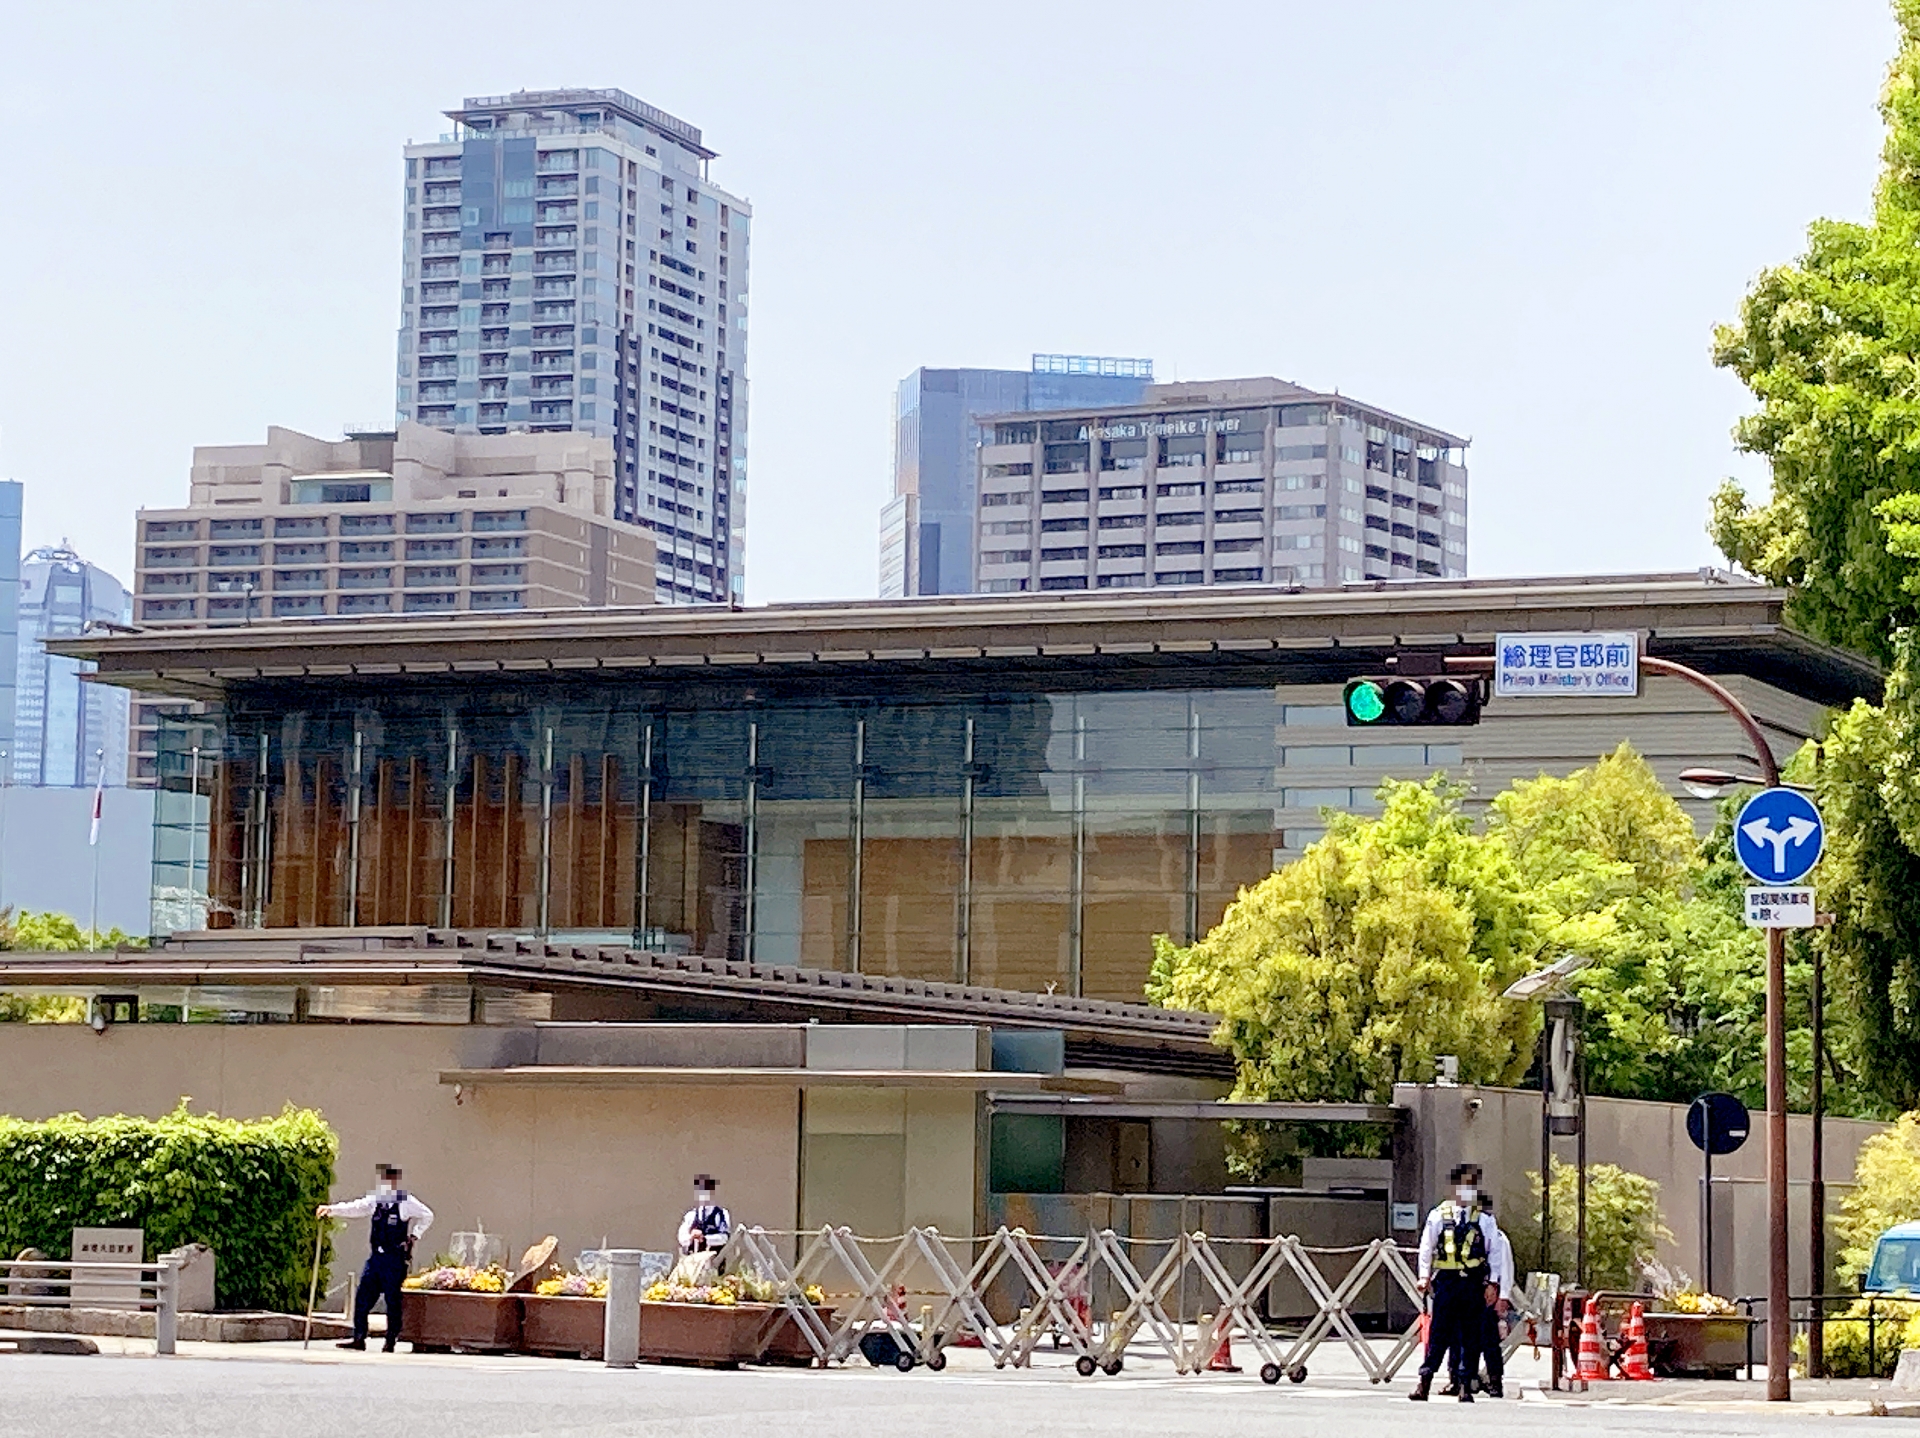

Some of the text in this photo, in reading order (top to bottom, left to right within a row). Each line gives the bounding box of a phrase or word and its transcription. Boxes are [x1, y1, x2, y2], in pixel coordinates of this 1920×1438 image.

[1079, 418, 1240, 440] Akasaka Tameike Twer
[1503, 643, 1631, 668] 総理官邸前
[1503, 672, 1629, 687] Prime Minister's Office
